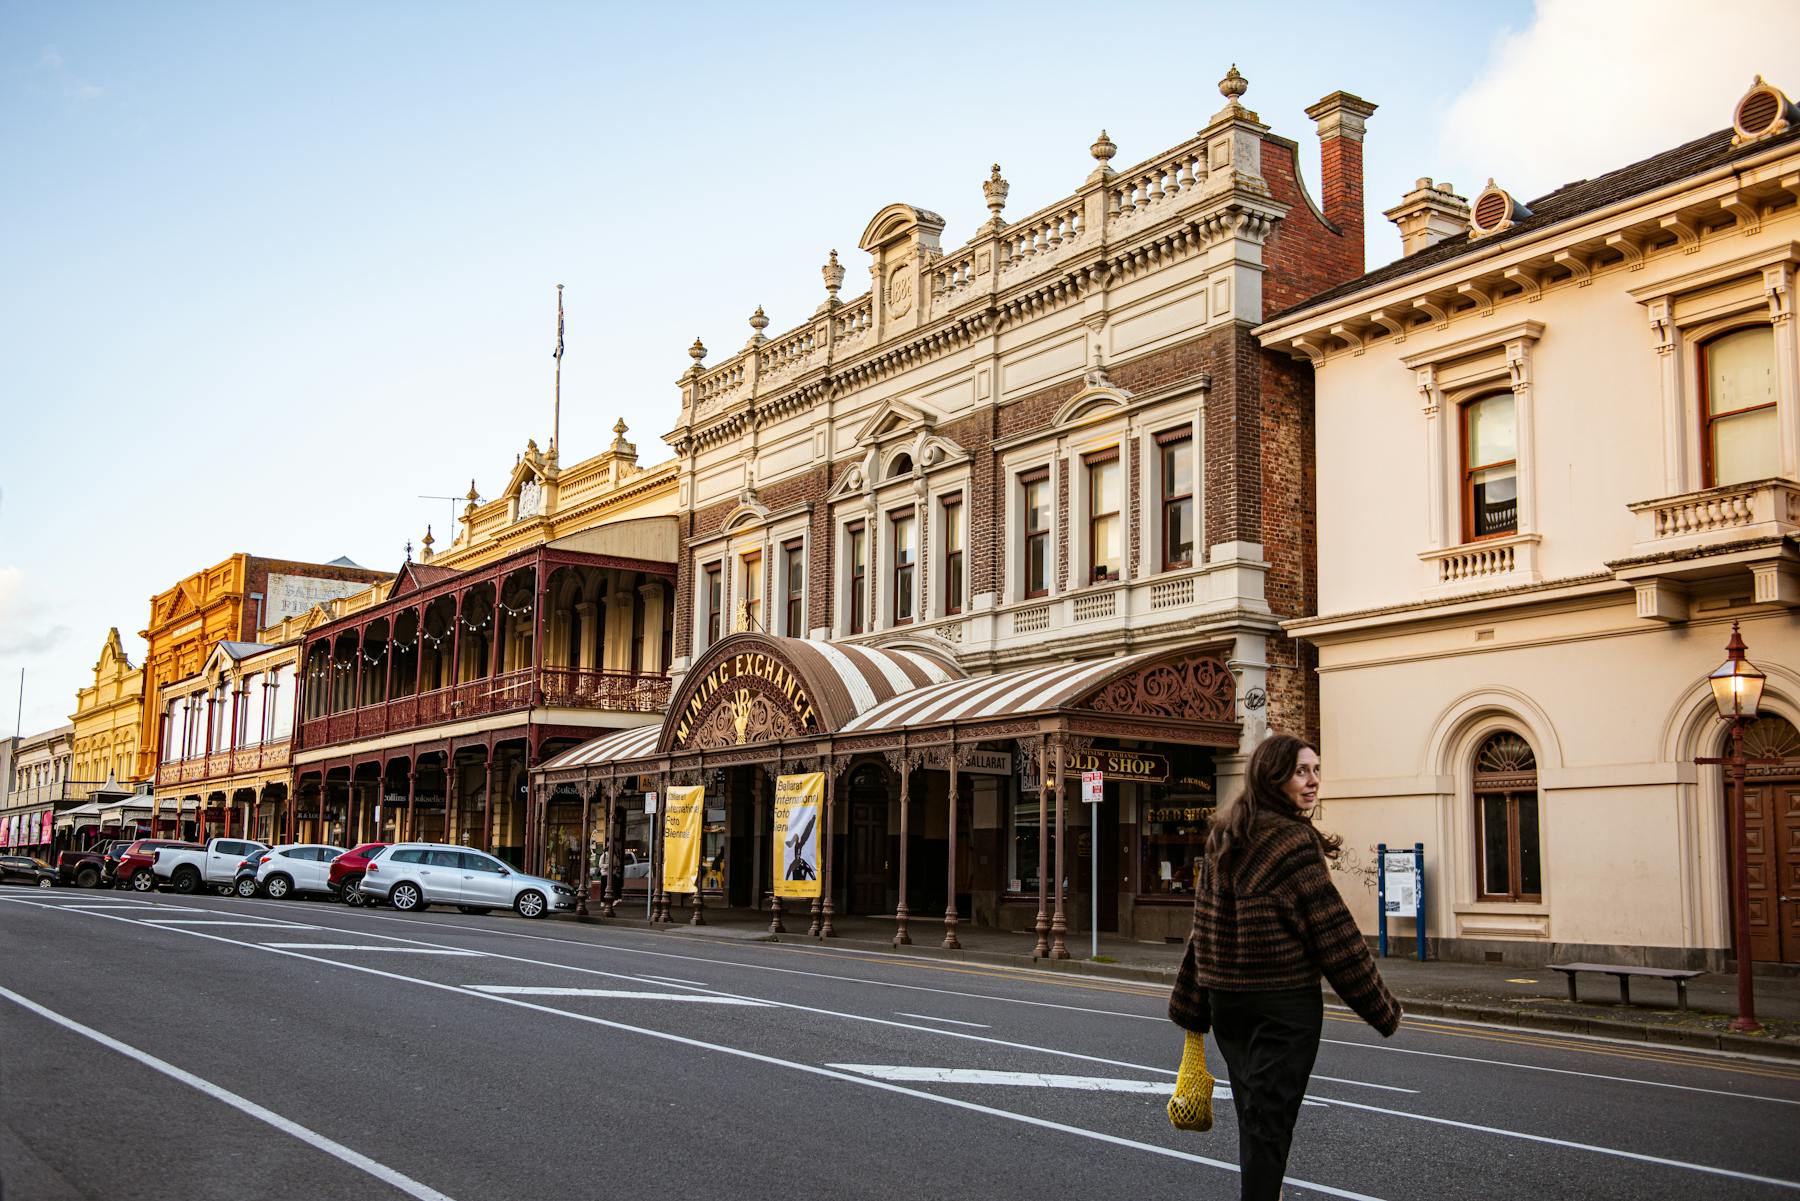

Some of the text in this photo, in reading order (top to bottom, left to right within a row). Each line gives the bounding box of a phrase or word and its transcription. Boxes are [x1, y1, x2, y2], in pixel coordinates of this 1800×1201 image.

[676, 653, 815, 745] MINING EXCHANGE
[1108, 757, 1156, 775] SHOP
[666, 815, 680, 826] Foto
